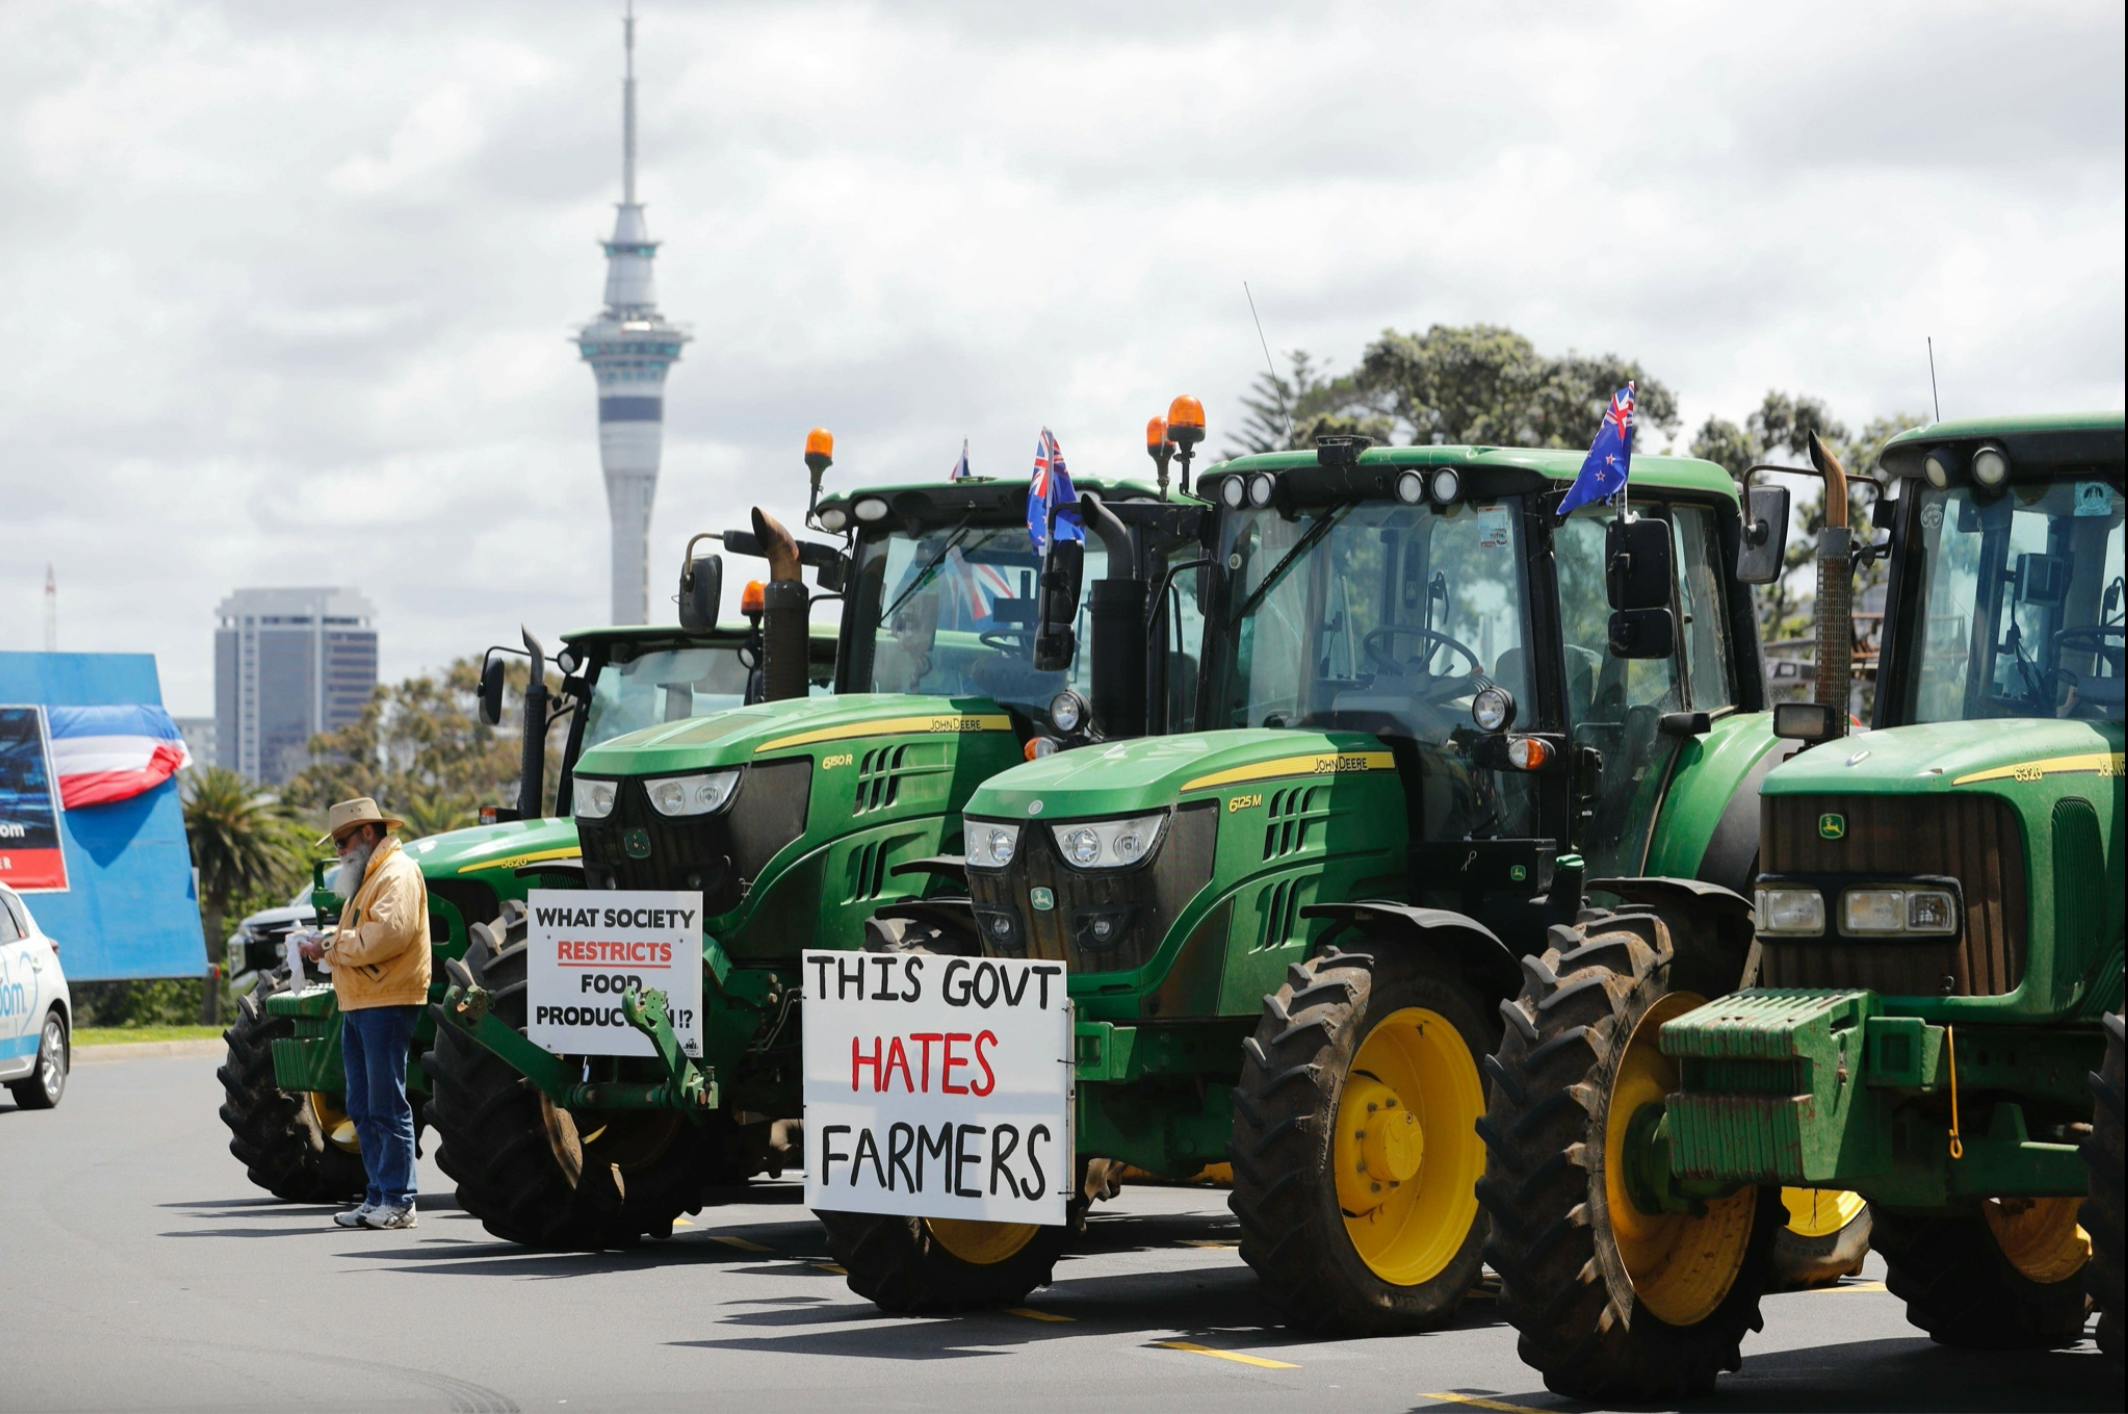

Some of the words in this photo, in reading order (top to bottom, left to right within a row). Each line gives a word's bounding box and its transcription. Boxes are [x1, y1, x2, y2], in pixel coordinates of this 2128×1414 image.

[536, 907, 599, 927] WHAT
[604, 908, 695, 929] SOCIETY
[557, 941, 672, 962] RESTRICTS
[581, 974, 642, 994] FOOD
[807, 955, 924, 1003] THIS
[942, 959, 1062, 1010] GOVT
[536, 1005, 675, 1029] PRODUC
[852, 1029, 998, 1097] HATES
[822, 1121, 1051, 1201] FARMERS
